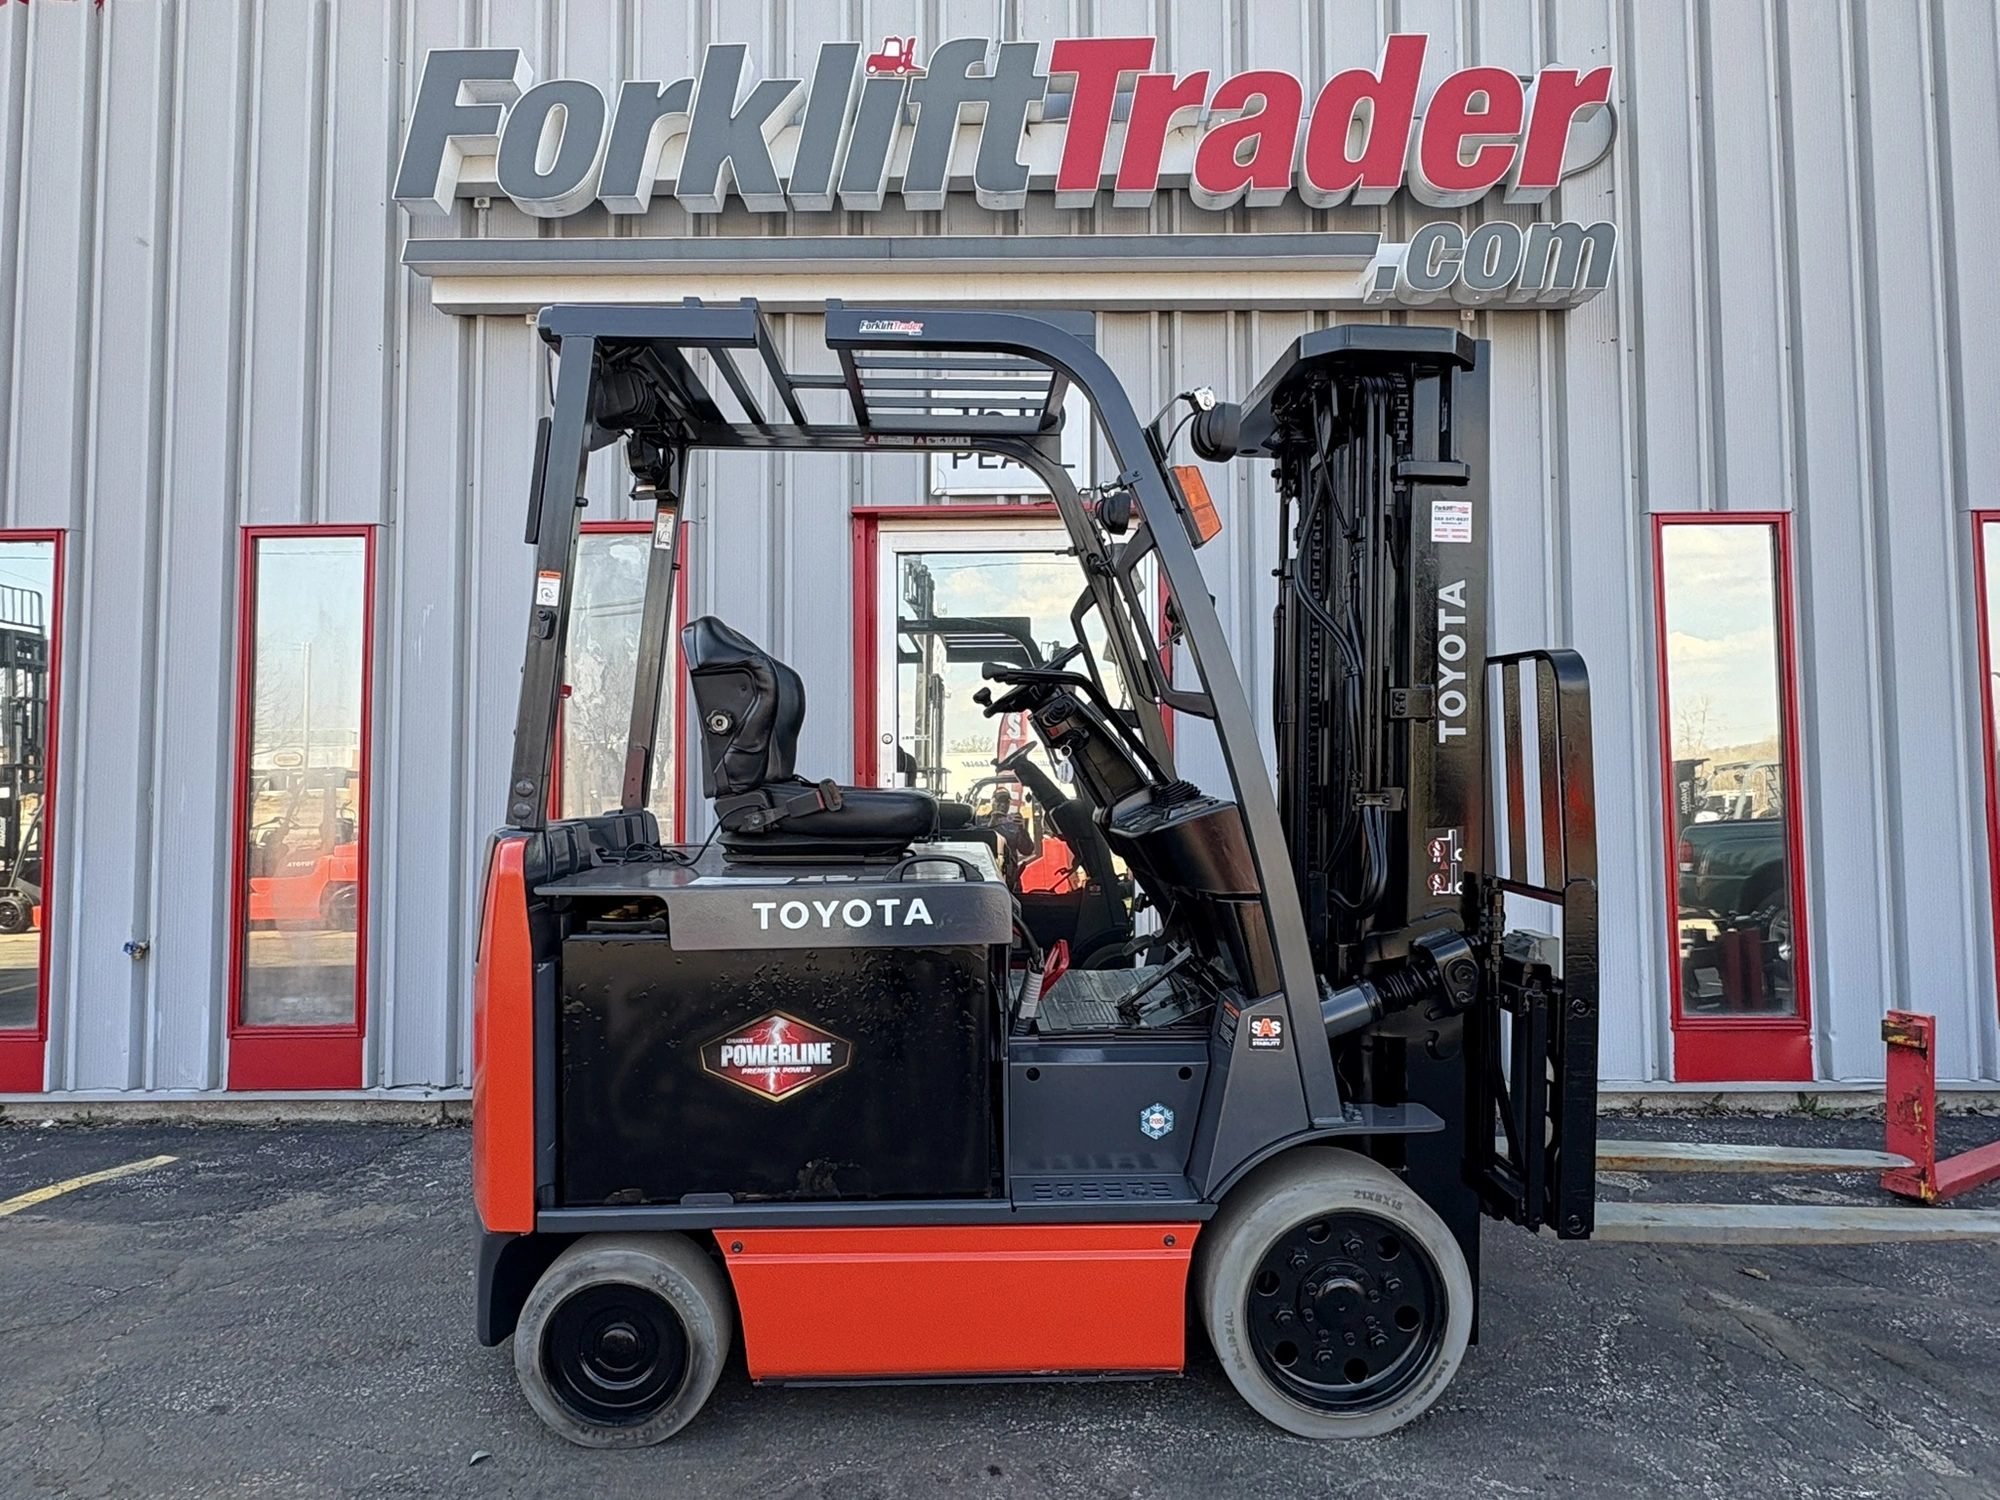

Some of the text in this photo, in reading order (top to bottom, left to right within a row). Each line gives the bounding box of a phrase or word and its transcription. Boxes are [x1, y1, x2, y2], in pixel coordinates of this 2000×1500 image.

[1438, 579, 1467, 744] TOYOTA
[752, 898, 934, 930] TOYOTA
[1251, 1018, 1282, 1037] SAS
[721, 1042, 832, 1067] POWERLINE
